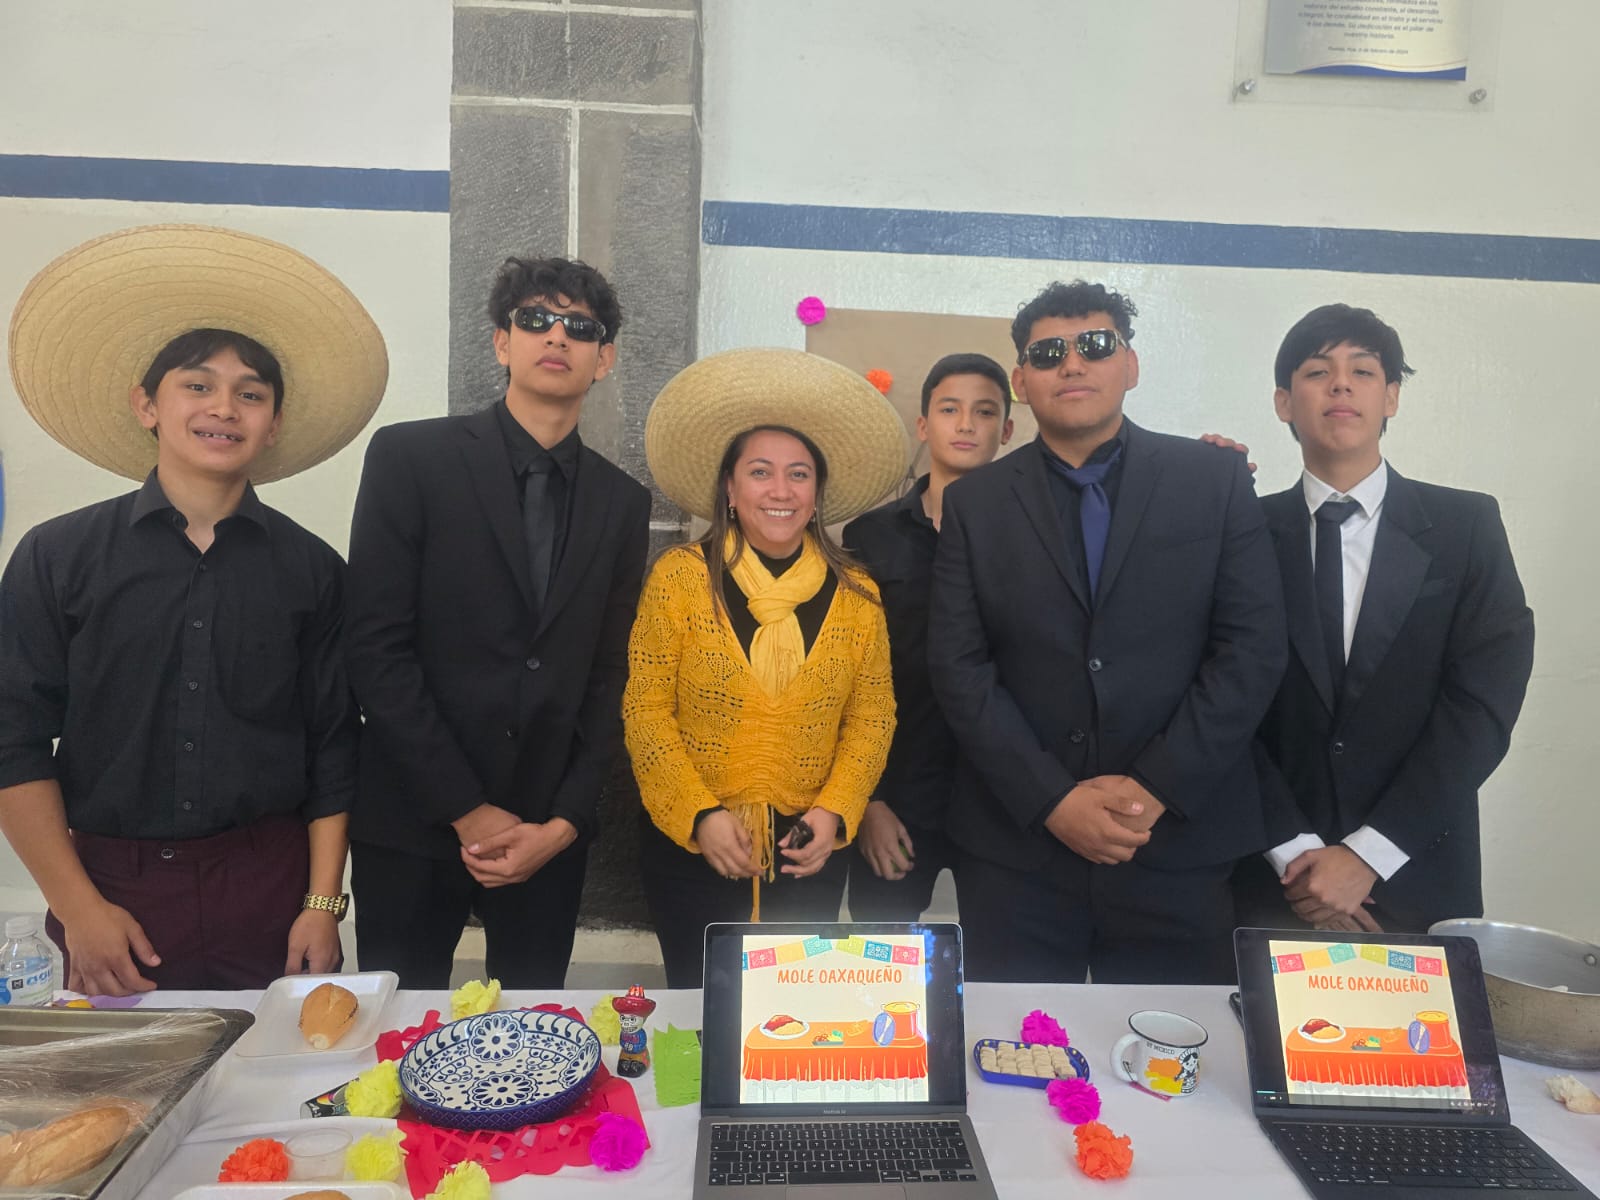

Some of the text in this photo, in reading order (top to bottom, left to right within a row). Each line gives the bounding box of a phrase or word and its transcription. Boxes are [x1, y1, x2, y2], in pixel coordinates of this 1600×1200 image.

[777, 965, 902, 985] MOLE OAXAQUEÑO
[1308, 975, 1429, 994] MOLE OAXAQUEÑO
